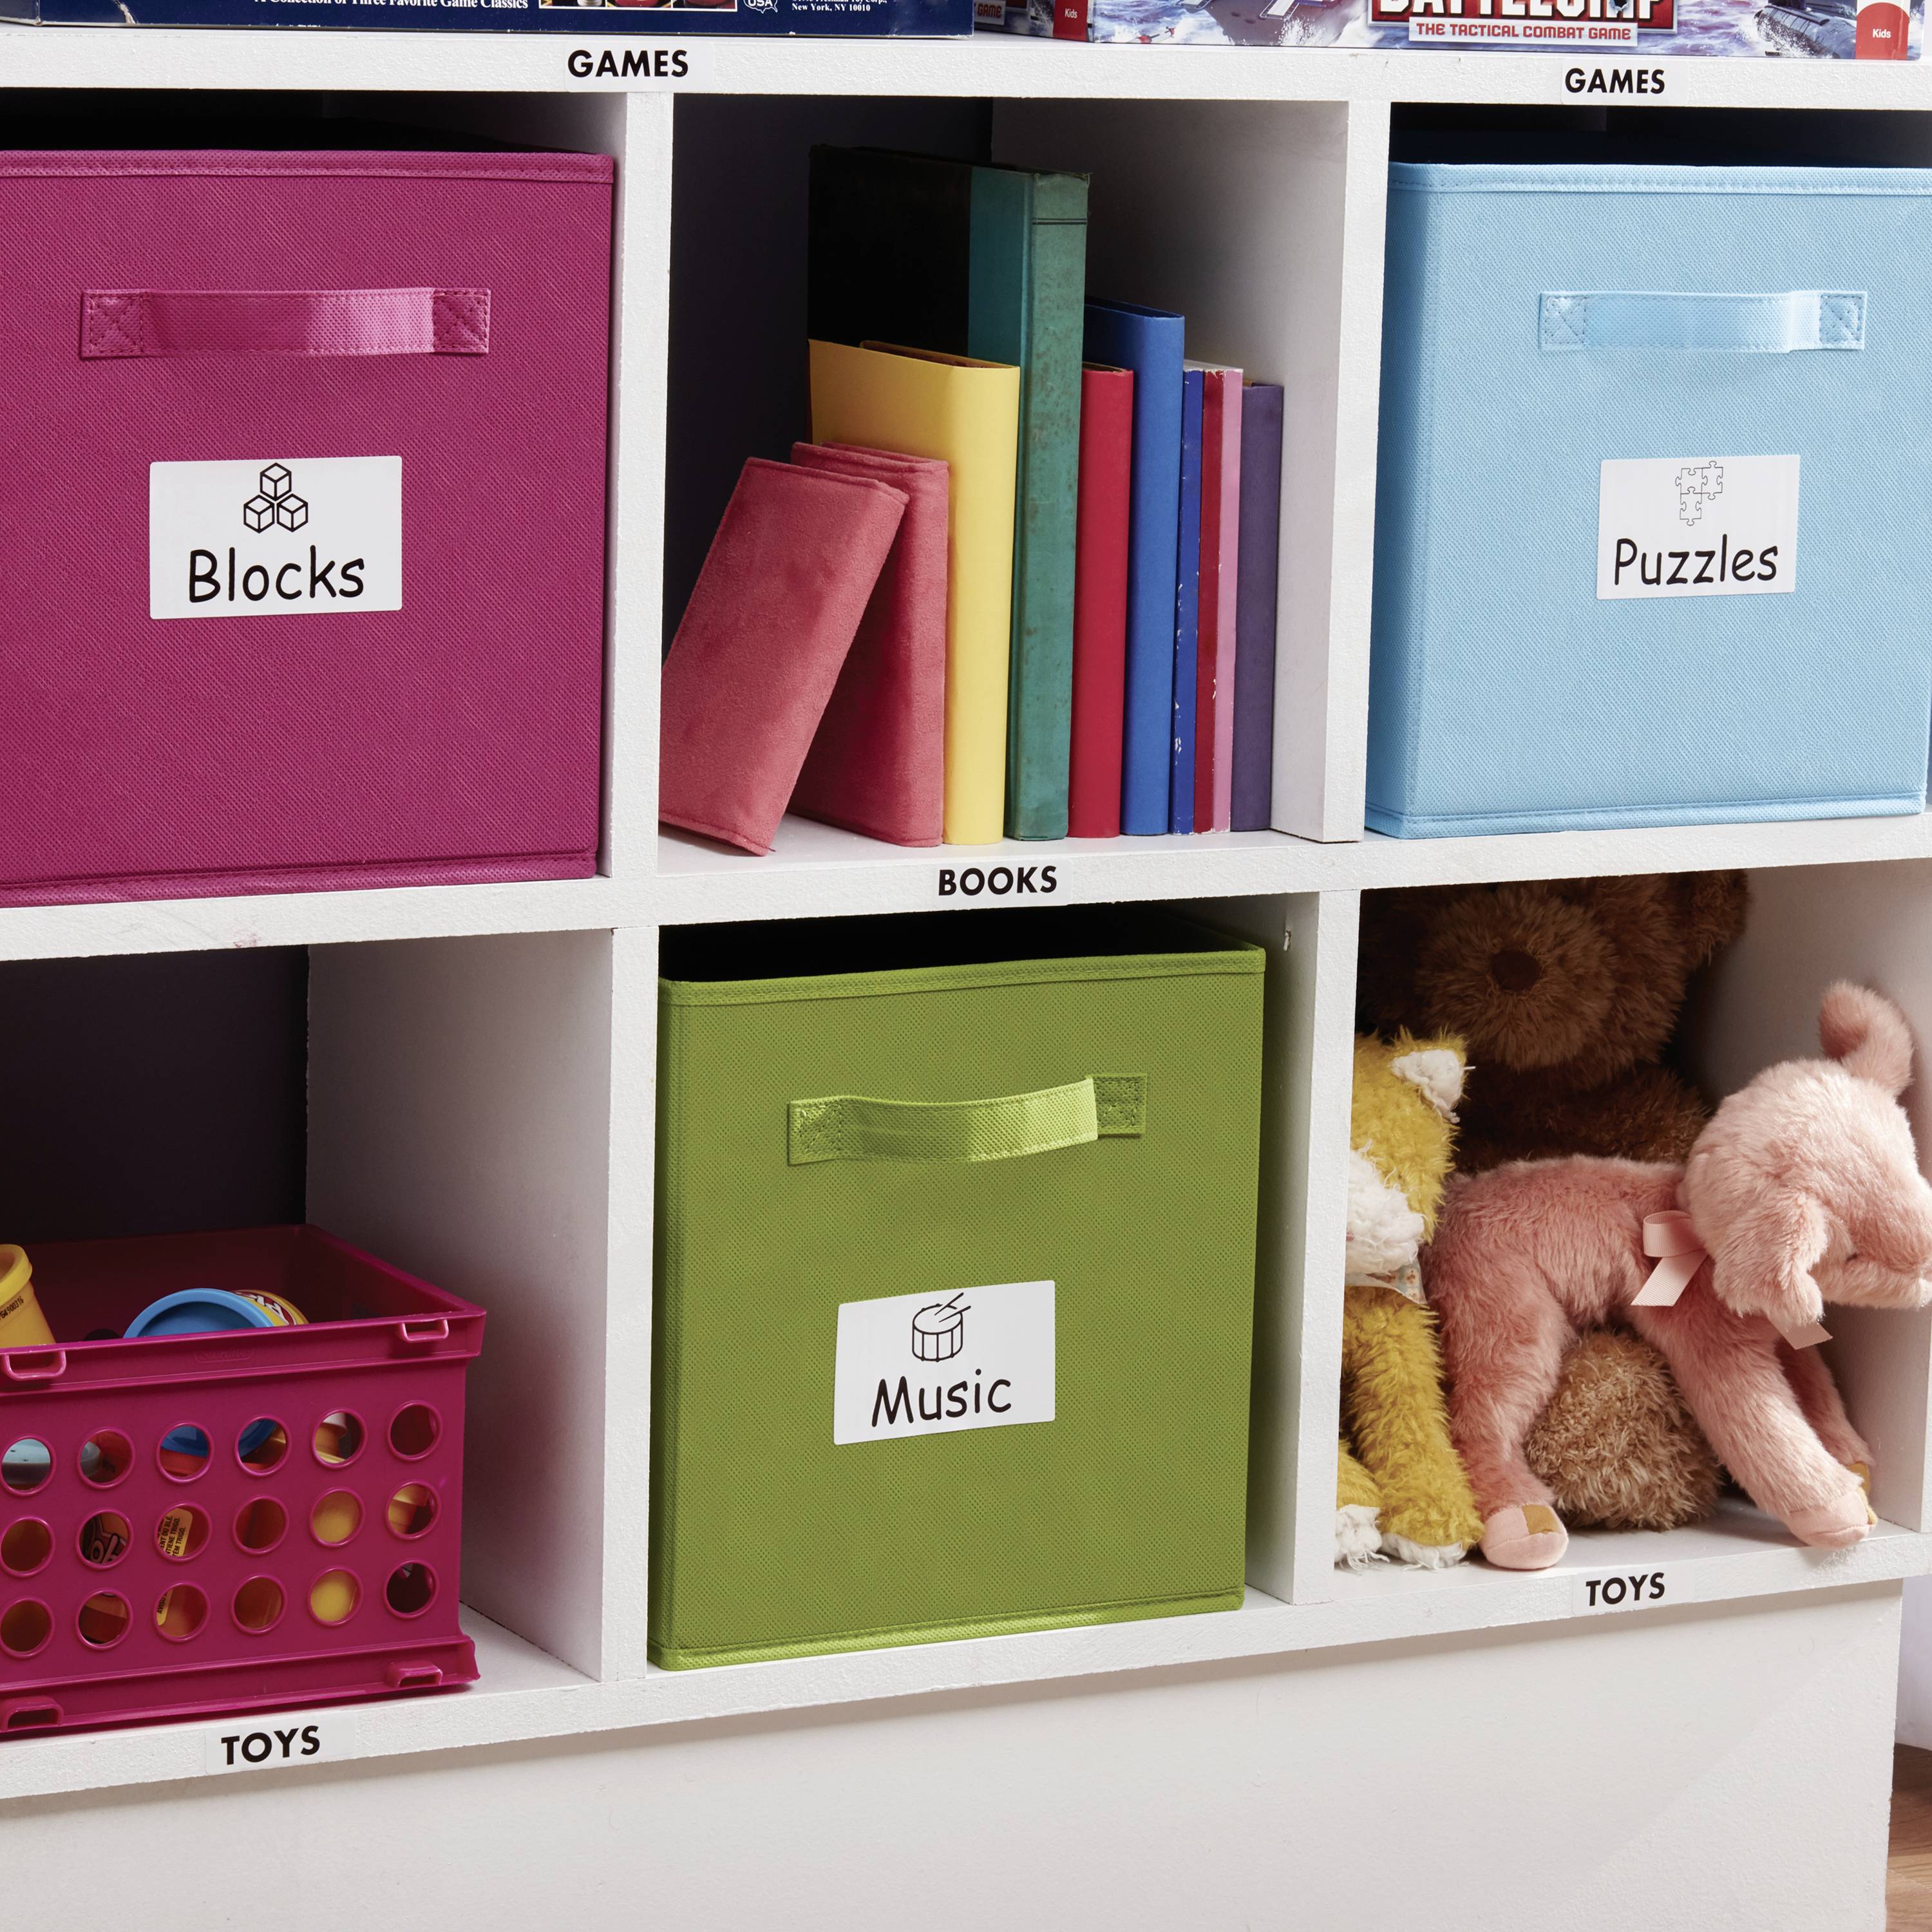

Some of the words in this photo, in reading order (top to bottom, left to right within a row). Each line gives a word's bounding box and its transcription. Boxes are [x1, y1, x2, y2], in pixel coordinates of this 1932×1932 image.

[480, 0, 528, 8] Classics
[811, 3, 833, 12] York,
[977, 3, 1002, 18] GAME
[1065, 8, 1077, 19] Kids
[1416, 23, 1445, 35] THE
[1450, 23, 1519, 37] TACTICAL
[1523, 25, 1584, 39] COMBAT
[1588, 28, 1631, 40] GAME
[1872, 28, 1891, 39] Kids
[567, 50, 688, 78] GAMES
[1565, 68, 1665, 94] GAMES
[1615, 534, 1778, 585] Puzzles
[189, 545, 365, 603] Blocks
[939, 866, 1057, 896] BOOKS
[871, 1368, 1012, 1427] Music
[1586, 1572, 1665, 1606] TOYS
[221, 1725, 320, 1765] TOYS
